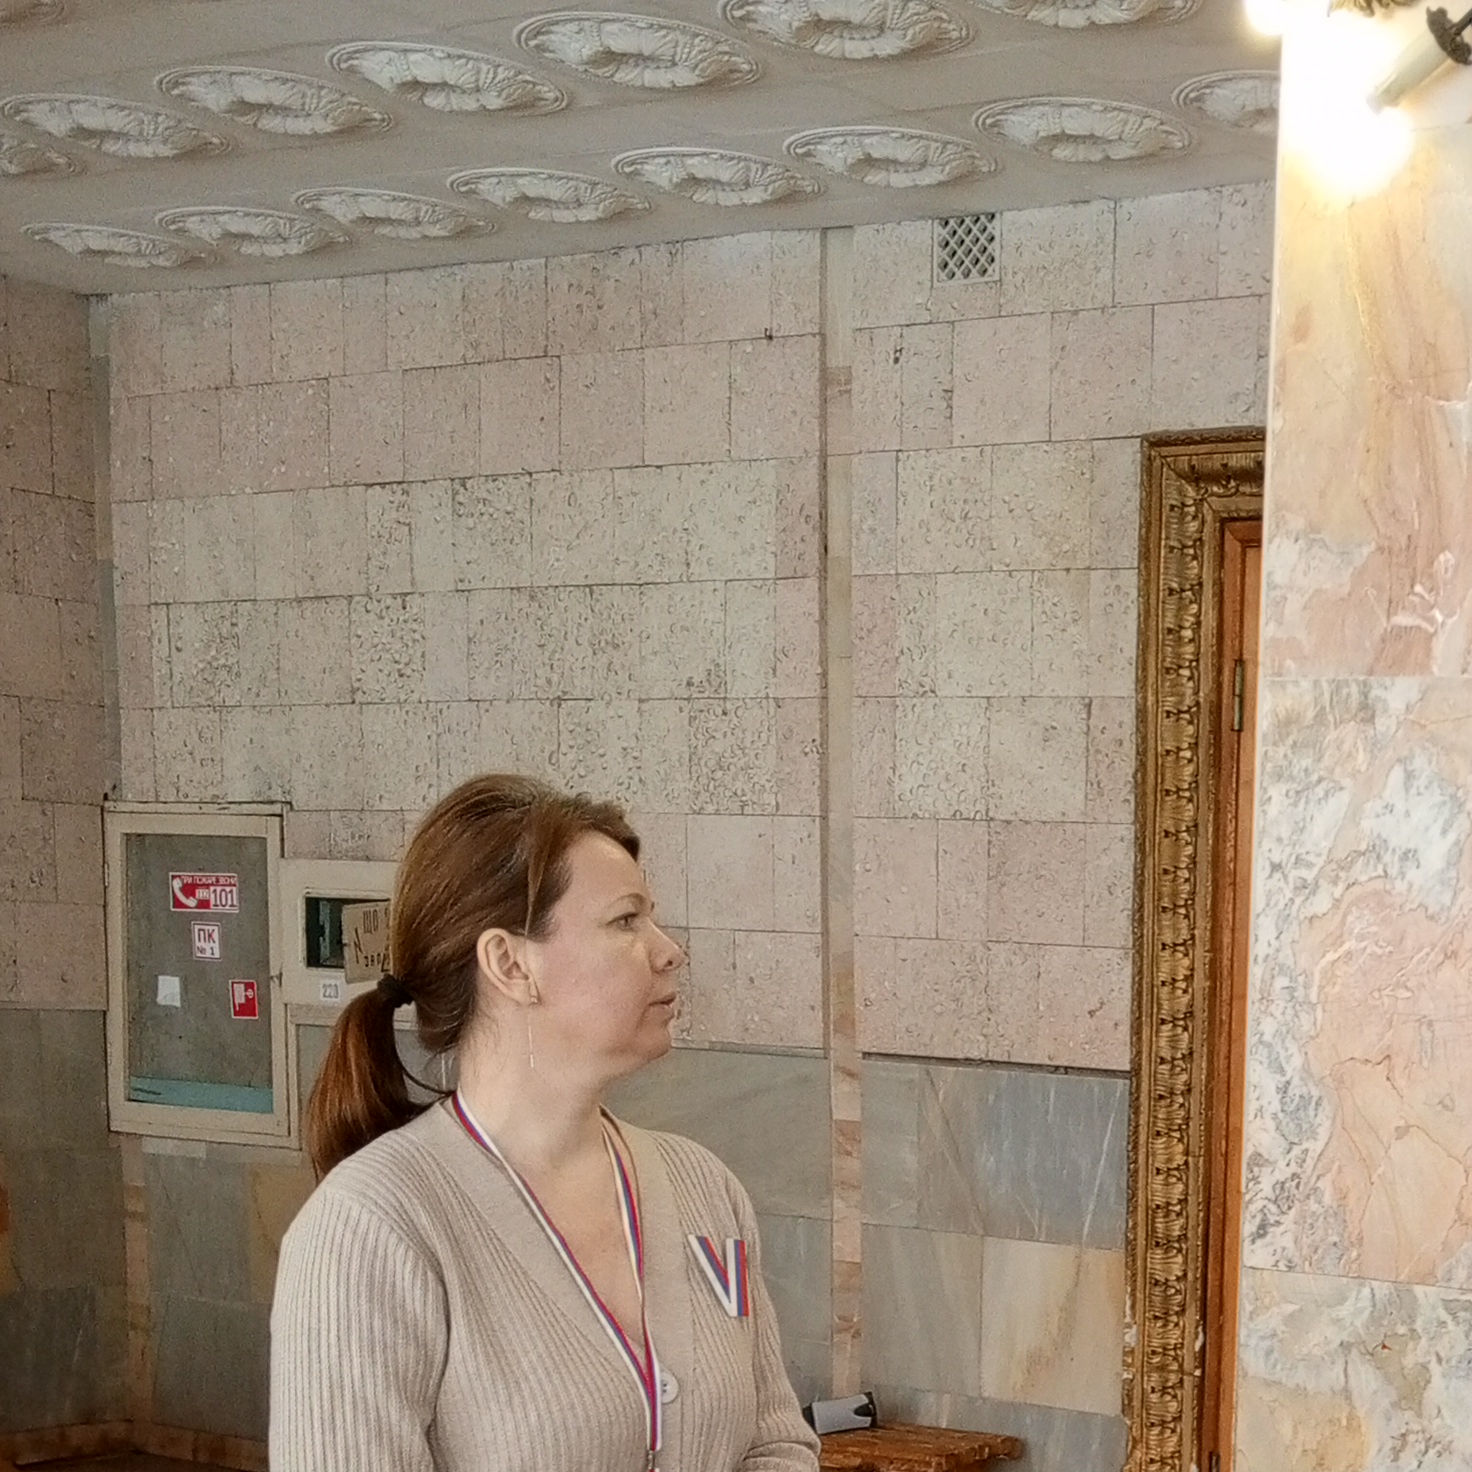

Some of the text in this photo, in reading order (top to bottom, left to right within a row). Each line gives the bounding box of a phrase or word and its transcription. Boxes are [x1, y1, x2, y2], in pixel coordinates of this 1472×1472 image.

[212, 888, 237, 908] 101
[197, 928, 216, 944] ПК
[210, 946, 215, 956] 1
